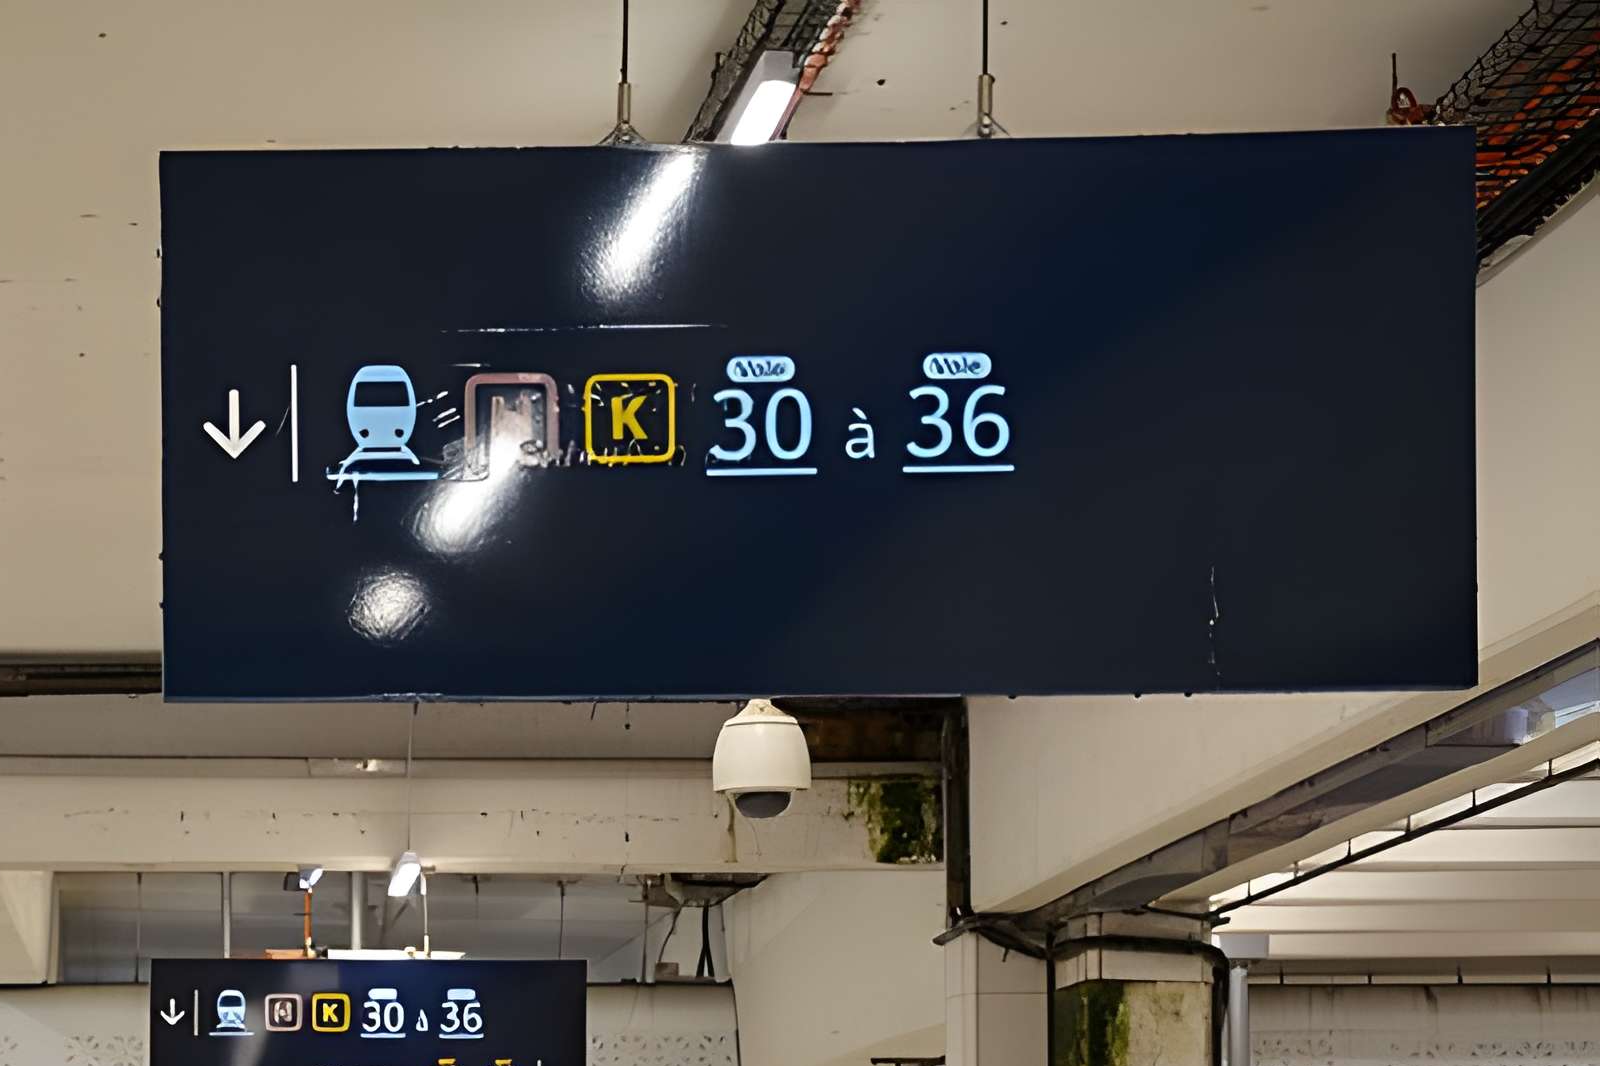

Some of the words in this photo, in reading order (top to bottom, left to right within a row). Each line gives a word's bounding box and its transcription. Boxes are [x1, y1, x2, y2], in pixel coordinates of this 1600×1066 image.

[611, 394, 648, 440] K
[709, 388, 813, 461] 30
[845, 407, 876, 459] à
[906, 384, 1011, 458] 36
[322, 1003, 339, 1023] K
[361, 1001, 405, 1033] 30
[440, 1001, 484, 1033] 36
